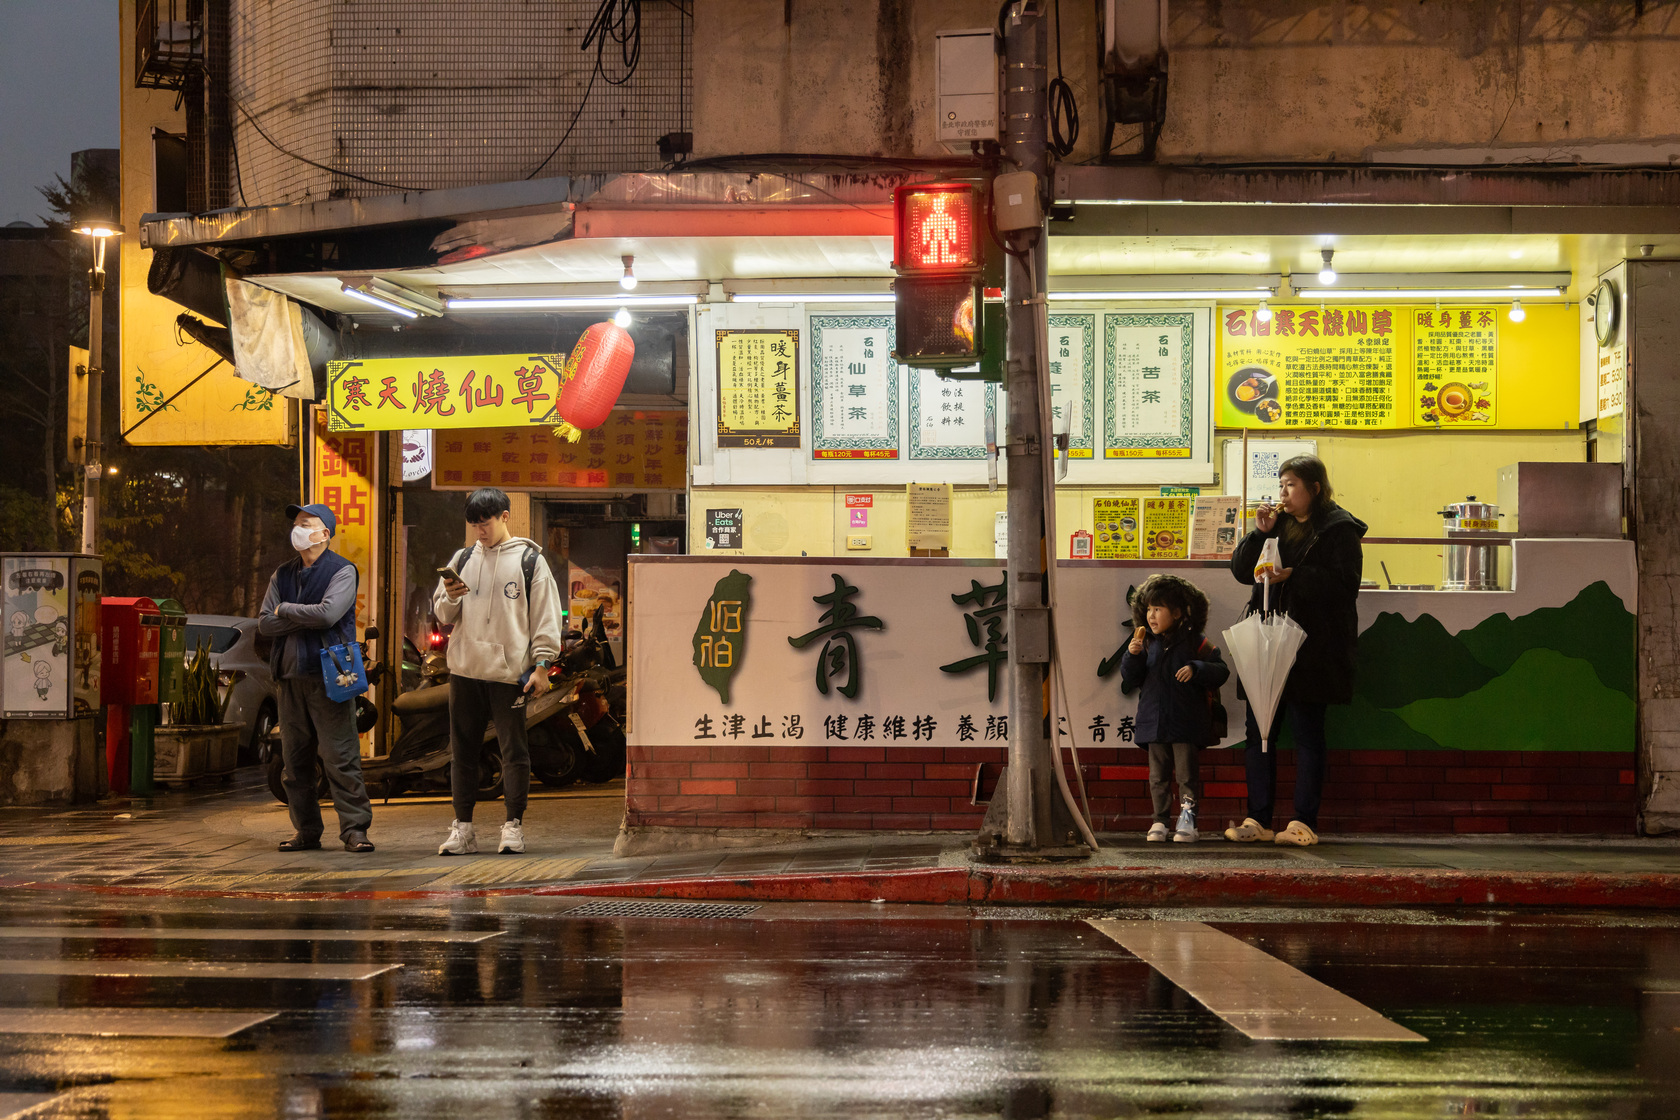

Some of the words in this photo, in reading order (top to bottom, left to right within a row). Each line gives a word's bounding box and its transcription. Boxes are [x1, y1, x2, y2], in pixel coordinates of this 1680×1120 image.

[1225, 309, 1393, 337] 石伯寒天燒仙草
[1417, 311, 1494, 329] 暖身薑茶
[863, 337, 874, 359] 石伯
[1059, 336, 1070, 357] 石伯
[1158, 335, 1169, 357] 石伯
[342, 365, 550, 416] 寒天燒仙草
[770, 340, 793, 422] 暖身薑茶
[847, 362, 867, 420] 仙草茶
[1141, 366, 1161, 404] 苦茶
[941, 378, 953, 426] 物飲料
[953, 378, 965, 426] 法提煉
[743, 438, 774, 446] 50元/杯
[821, 450, 852, 458] 每瓶120元
[863, 450, 890, 458] 每杯45元
[1112, 450, 1143, 458] 每瓶150元
[1155, 449, 1183, 457] 每杯55元
[322, 437, 367, 526] 鍋貼
[714, 511, 734, 519] Uber
[1095, 500, 1138, 508] 石伯燒仙草
[1147, 501, 1186, 509] 暖身薑茶
[714, 518, 734, 526] Eats
[694, 713, 805, 740] 生津止渴
[824, 713, 938, 741] 健康維持
